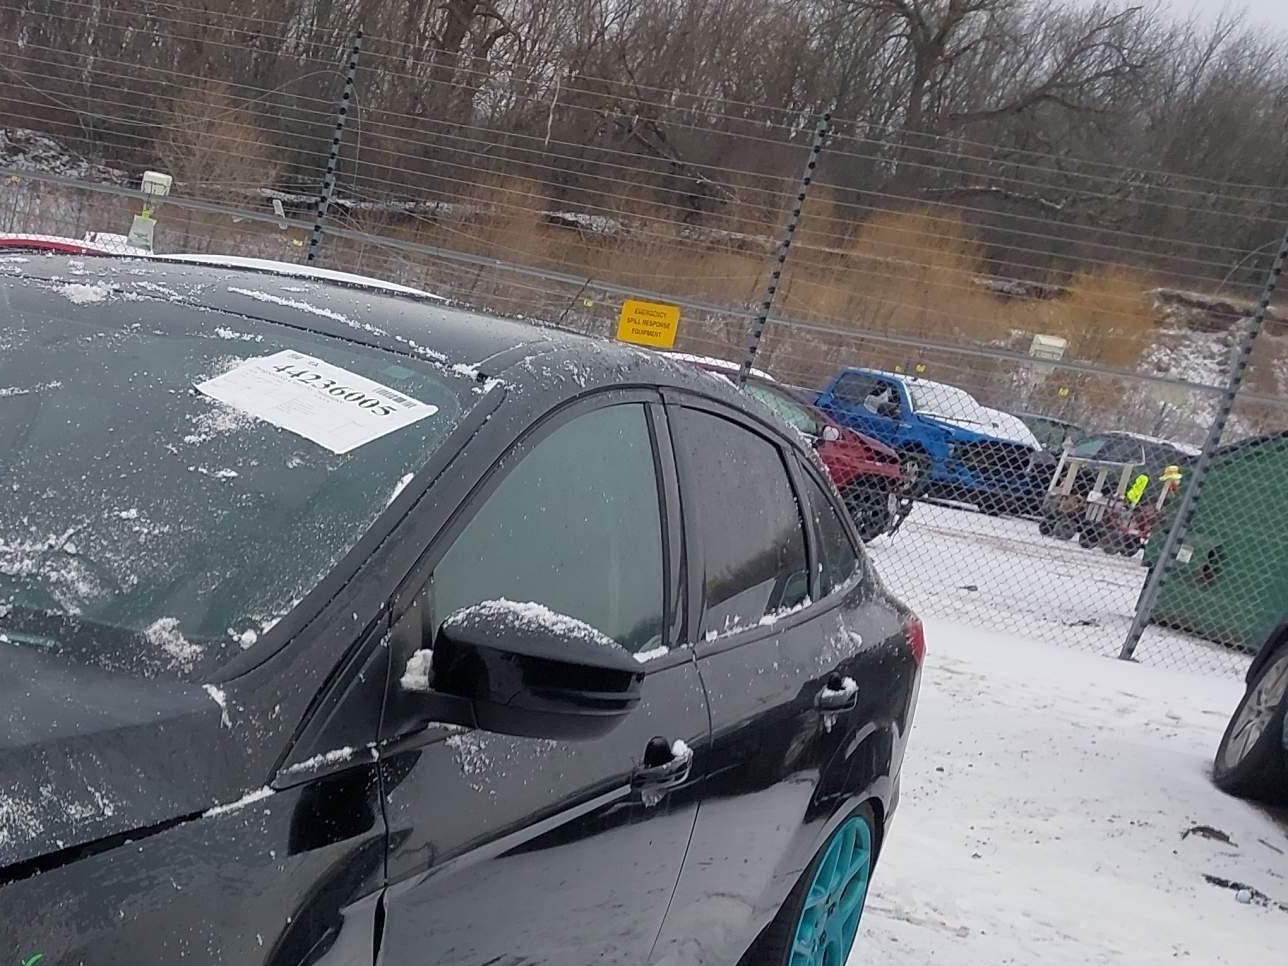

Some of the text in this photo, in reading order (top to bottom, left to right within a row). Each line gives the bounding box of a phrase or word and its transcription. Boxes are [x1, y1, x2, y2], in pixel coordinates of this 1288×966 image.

[627, 317, 671, 329] SPILL RESPONSE
[631, 328, 662, 337] EQUIPMENT
[272, 364, 398, 417] 44236005
